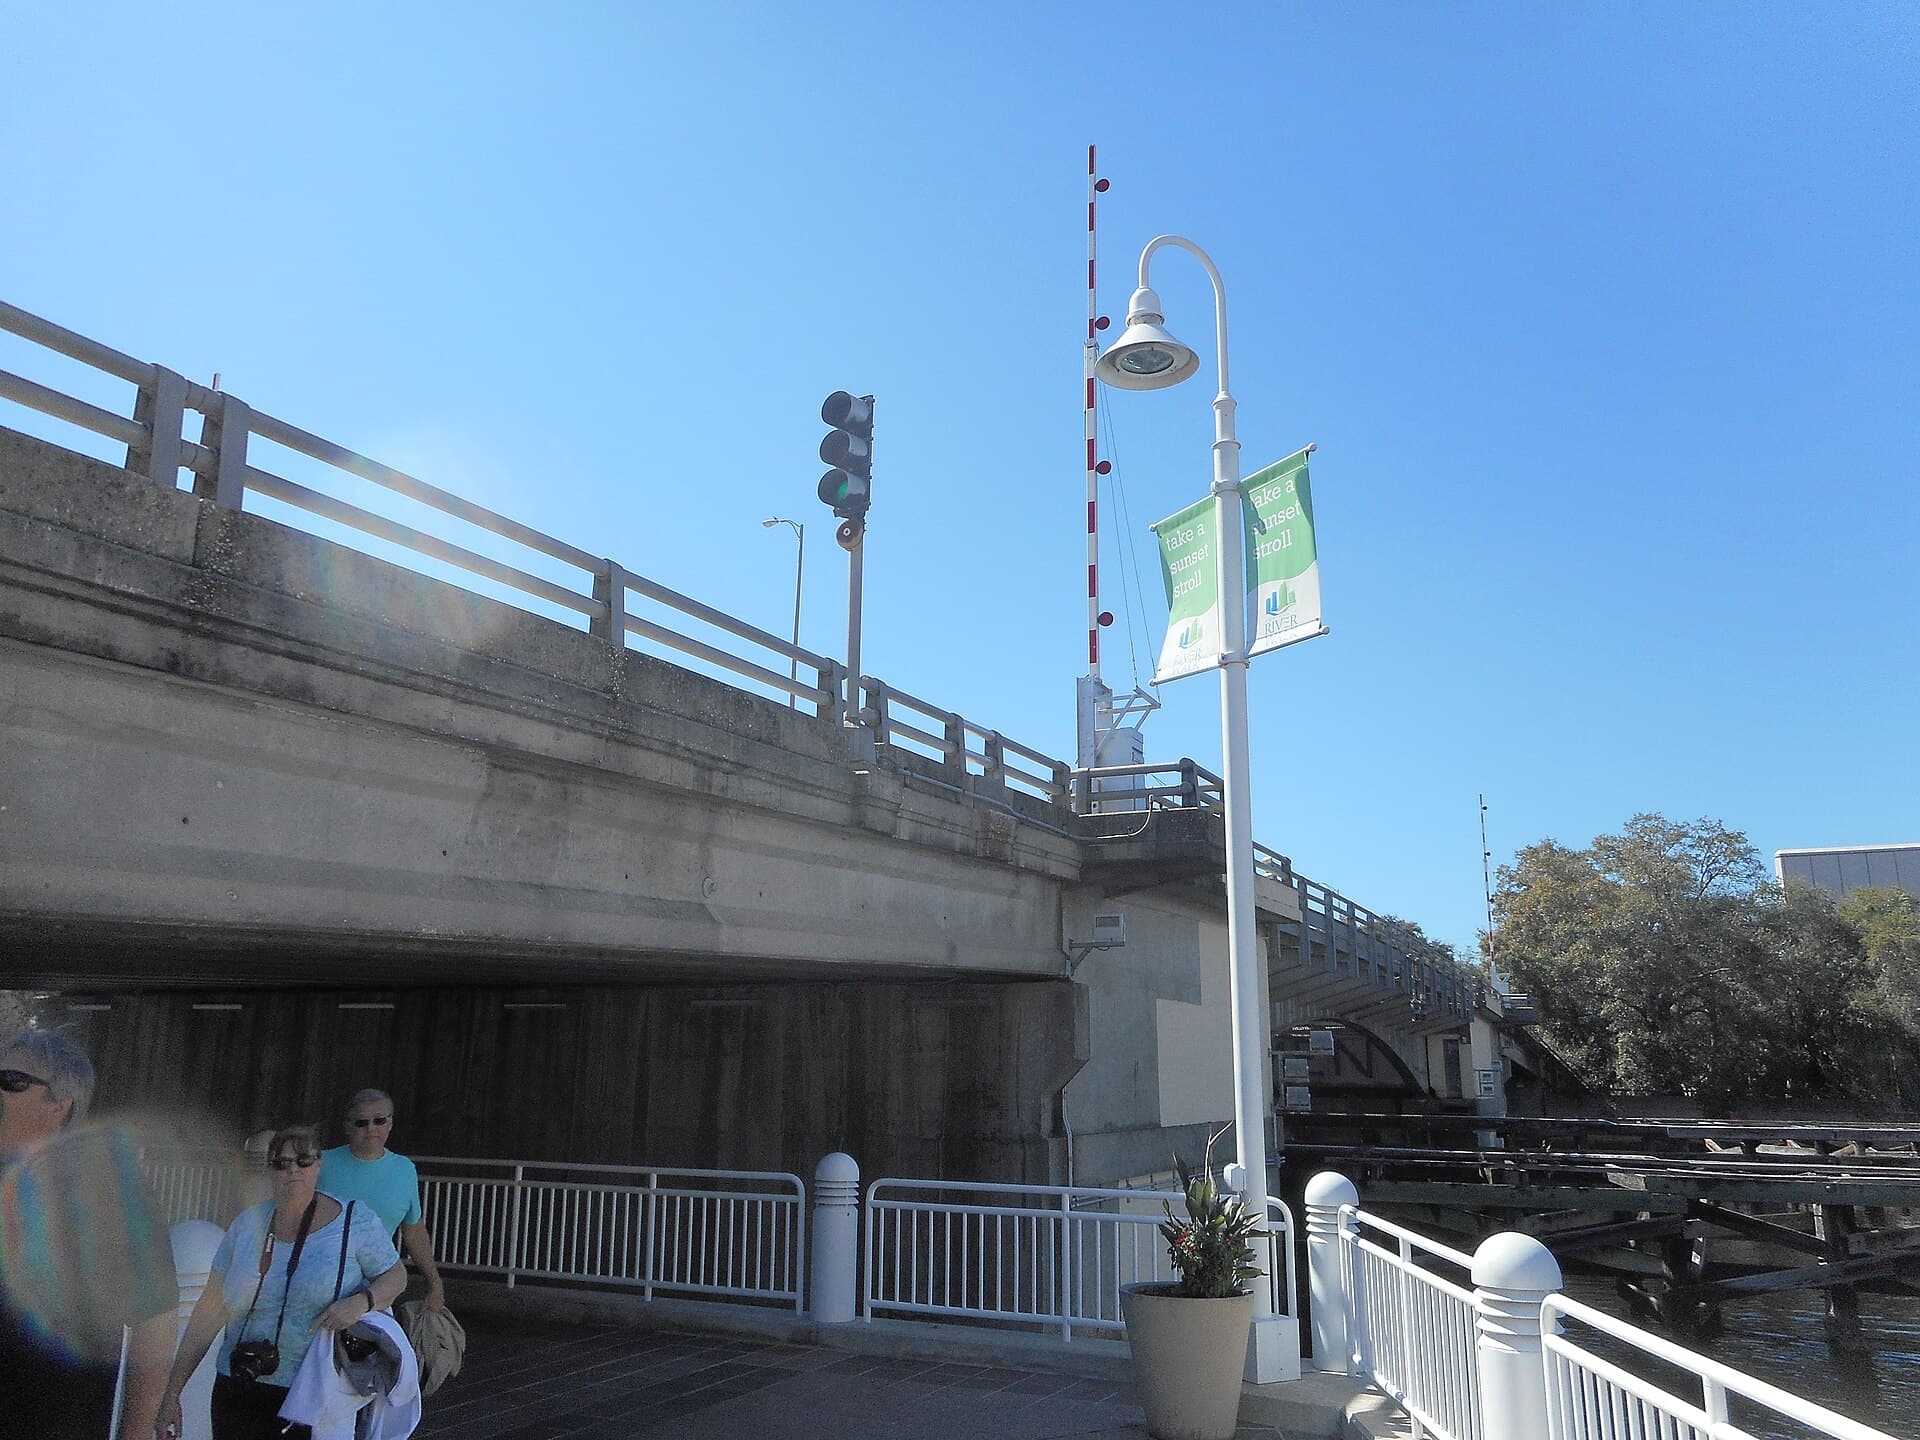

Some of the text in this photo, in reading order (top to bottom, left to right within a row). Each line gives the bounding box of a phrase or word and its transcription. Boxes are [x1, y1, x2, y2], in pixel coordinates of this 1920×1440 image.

[1285, 479, 1296, 493] a
[1166, 523, 1205, 552] take a
[1253, 528, 1292, 559] stroll
[1170, 543, 1208, 575] sunset
[1174, 569, 1202, 598] stroll
[1264, 614, 1298, 635] RIVER
